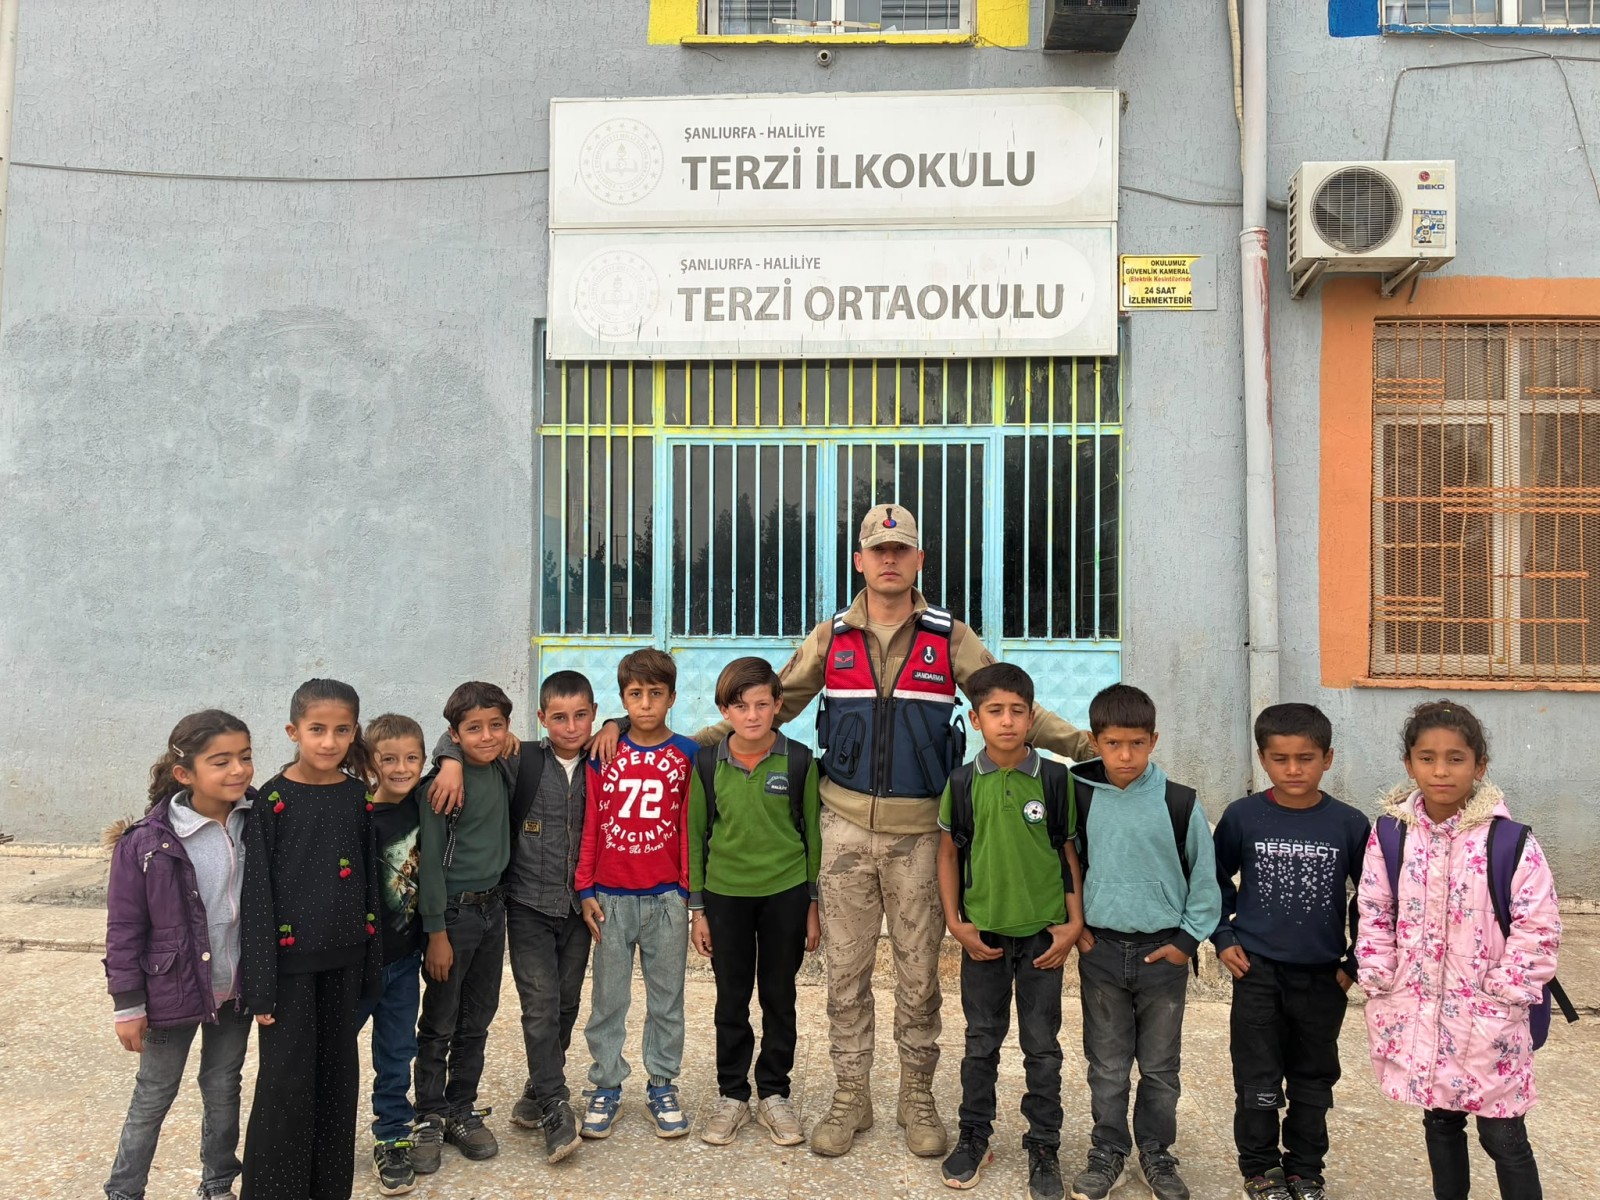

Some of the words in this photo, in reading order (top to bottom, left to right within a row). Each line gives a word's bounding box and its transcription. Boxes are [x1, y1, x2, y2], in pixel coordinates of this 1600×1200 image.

[684, 126, 757, 142] ŞANLIURFA
[767, 123, 826, 139] HALİLİYE
[681, 146, 802, 191] TERZİ
[816, 146, 1036, 190] İLKOKULU
[680, 257, 753, 274] ŞANLIURFA
[763, 254, 822, 270] HALİLİYE
[1125, 267, 1158, 275] GÜVENLİK
[1150, 259, 1187, 267] OKULUMUZ
[677, 277, 792, 322] TERZİ
[803, 283, 1065, 322] ORTAOKULU
[1128, 294, 1192, 304] İZLENMEKTEDİR
[1144, 286, 1154, 295] 24
[1155, 286, 1177, 294] SAAT
[914, 672, 945, 683] JANDARMA
[602, 751, 680, 794] SUPERDRY
[618, 778, 664, 819] 72
[1254, 841, 1340, 860] RESPECT
